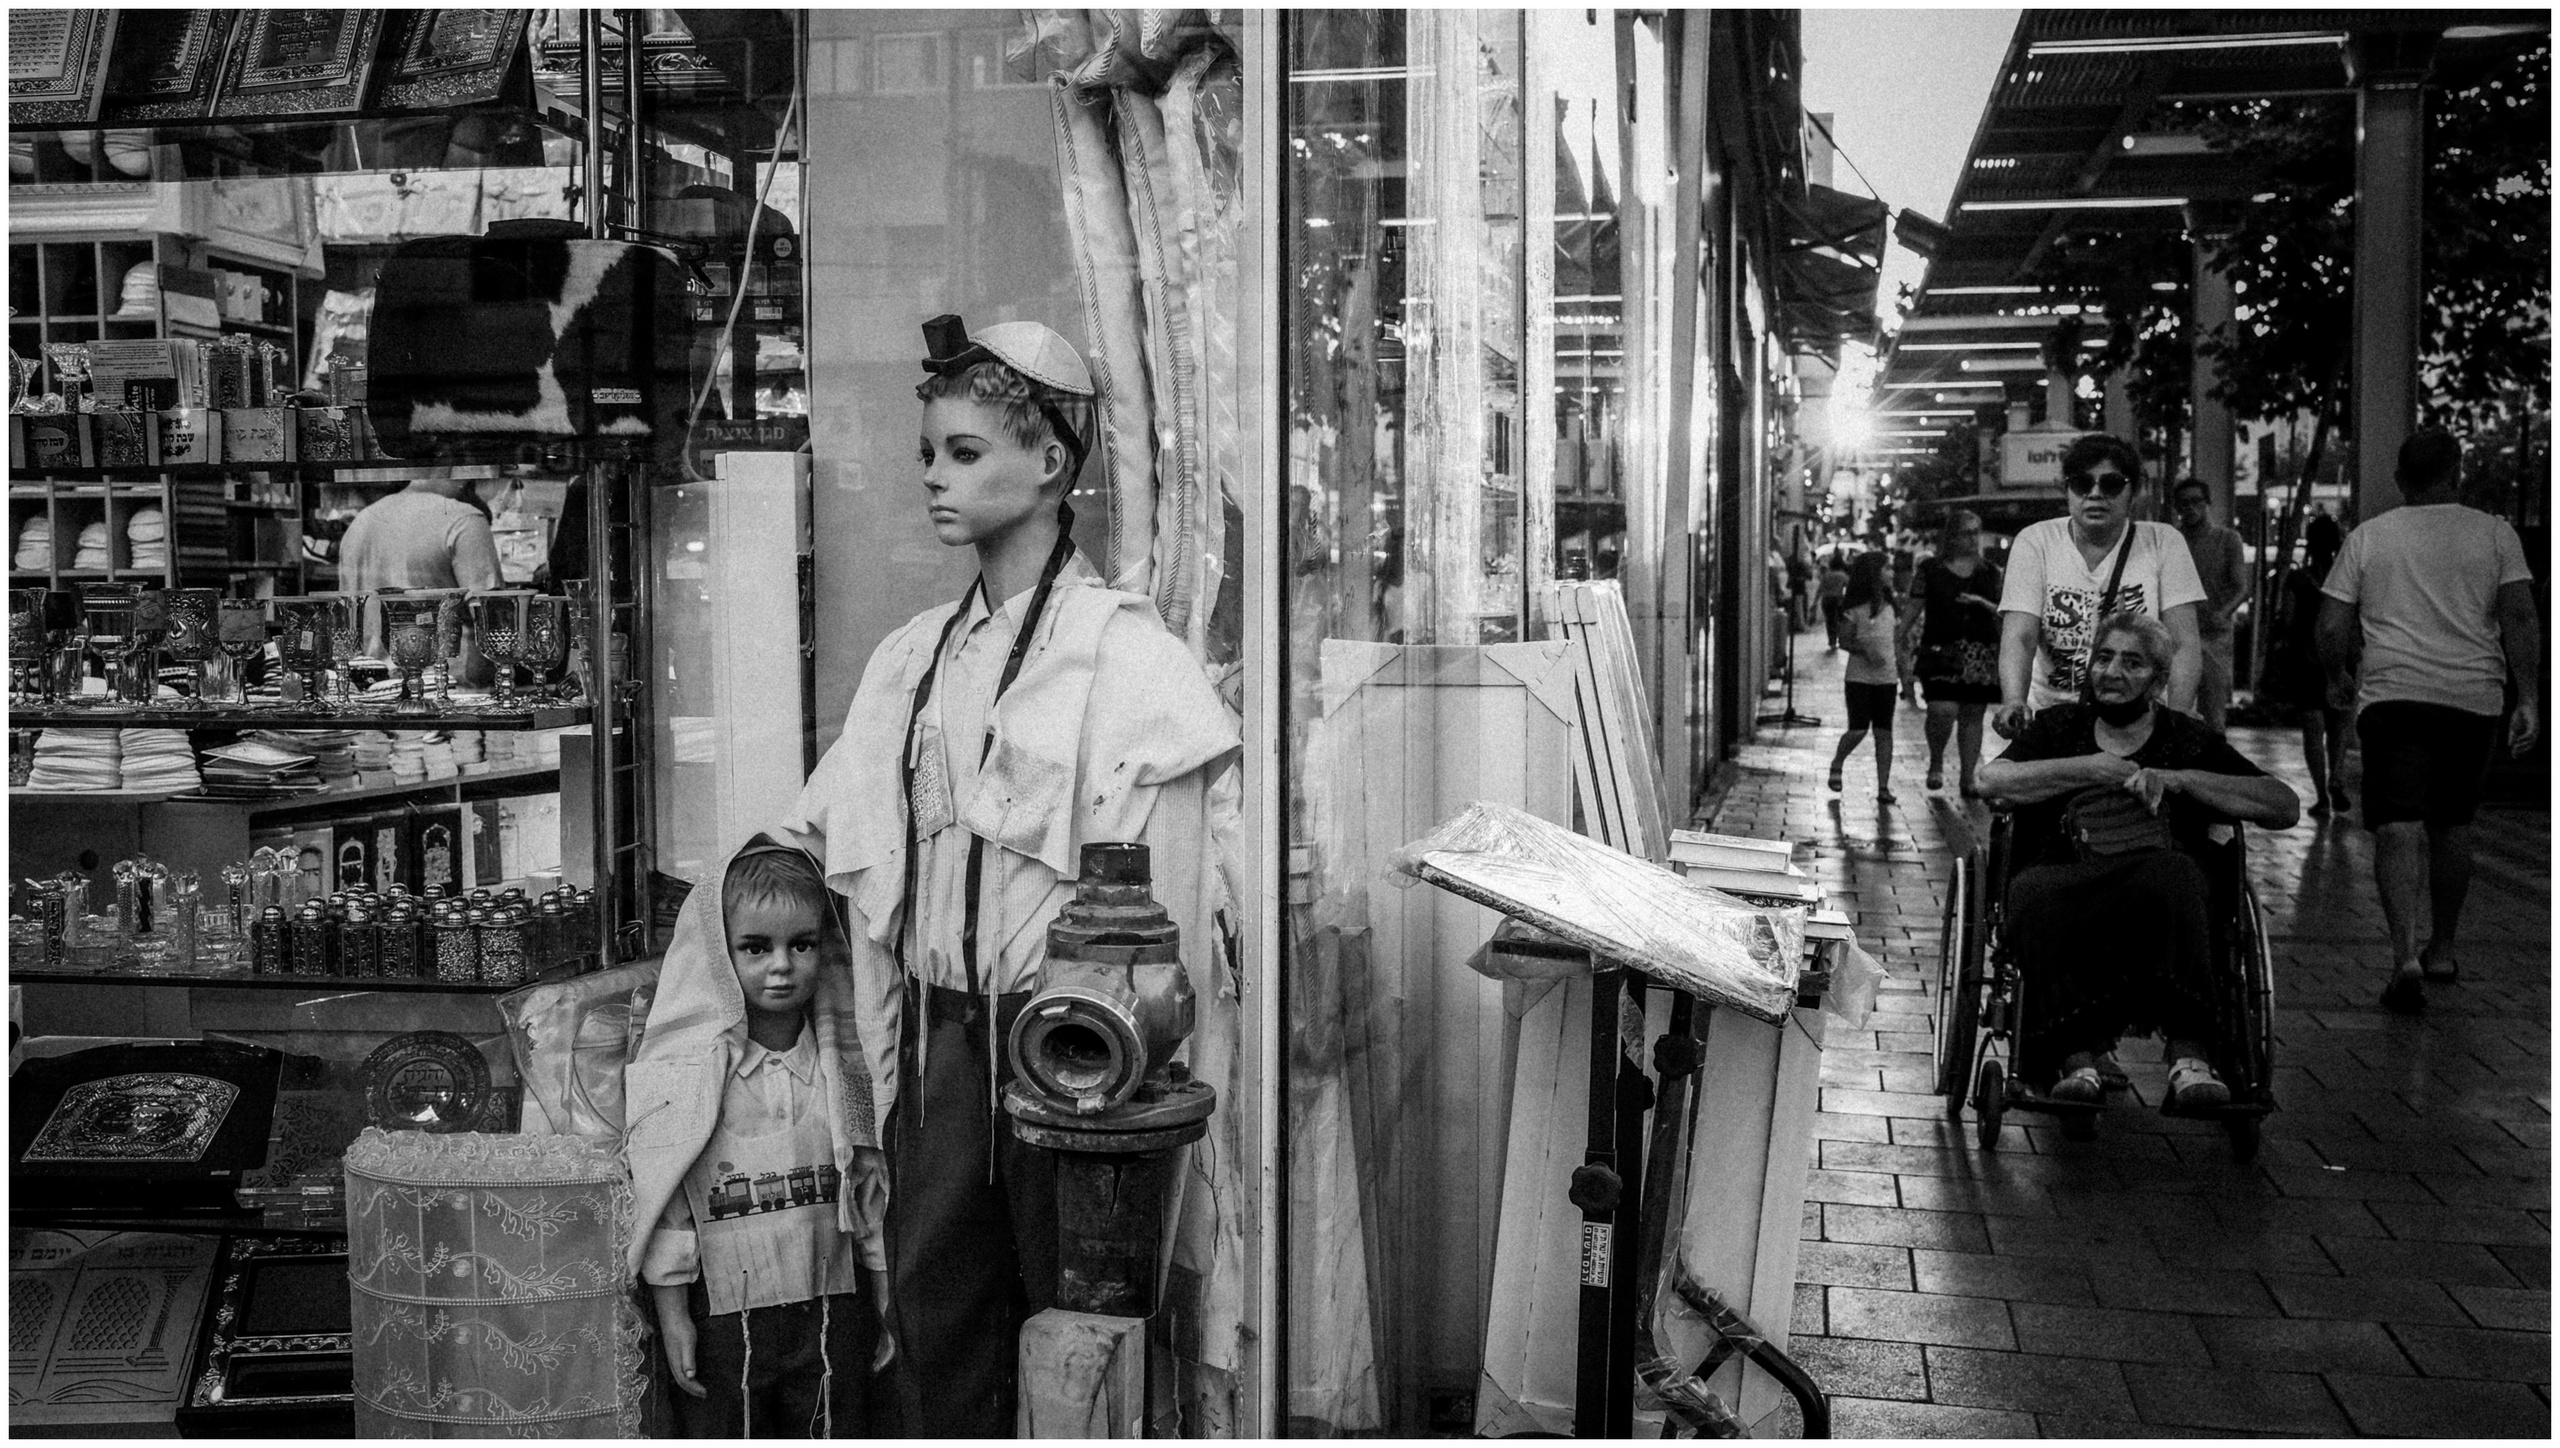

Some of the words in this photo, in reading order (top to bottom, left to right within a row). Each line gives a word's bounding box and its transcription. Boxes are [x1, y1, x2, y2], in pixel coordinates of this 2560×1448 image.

[176, 432, 195, 443] שבת
[704, 426, 753, 441] ציצית
[758, 426, 785, 444] מגן
[1583, 1226, 1592, 1257] רשום
[31, 1247, 72, 1260] יומם
[1581, 1260, 1590, 1282] דגם
